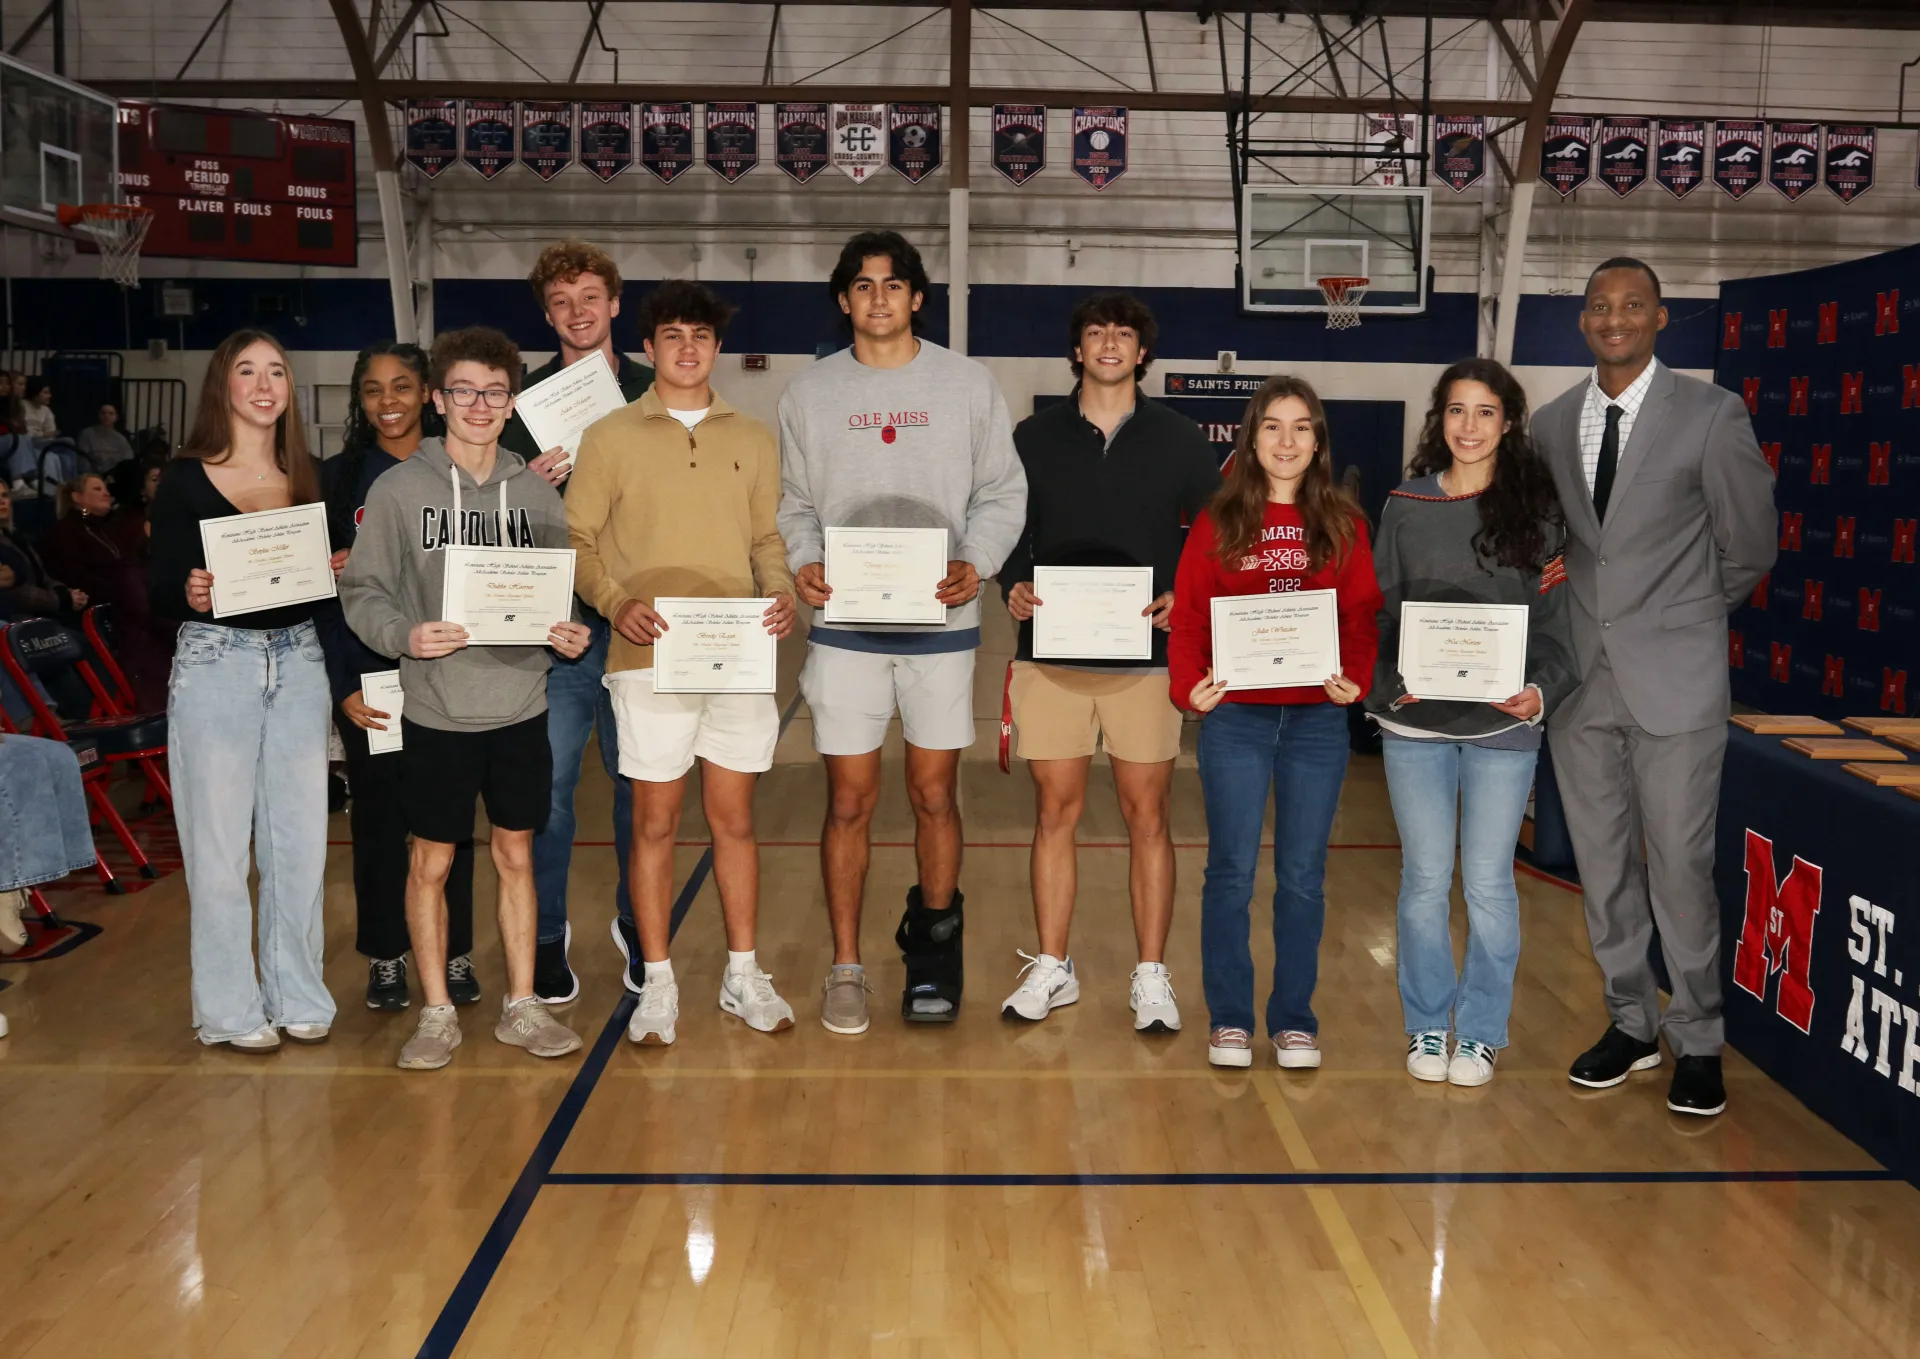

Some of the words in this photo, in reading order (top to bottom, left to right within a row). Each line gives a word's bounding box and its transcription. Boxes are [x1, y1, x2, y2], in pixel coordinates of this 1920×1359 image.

[996, 114, 1043, 132] CHAMPIONS
[1075, 116, 1126, 135] CHAMPIONS
[1437, 122, 1482, 140] CHAMPIONS
[288, 124, 351, 144] VISITOR
[1716, 130, 1762, 148] CHAMPIONS
[194, 160, 220, 170] POSS
[1089, 166, 1110, 174] 2024
[184, 170, 230, 184] PERIOD
[288, 185, 327, 199] BONUS
[178, 198, 224, 213] PLAYER
[234, 202, 272, 216] FOULS
[296, 206, 334, 220] FOULS
[1188, 380, 1231, 390] SAINTS
[1234, 380, 1264, 390] PRID
[849, 412, 882, 427] OLE
[888, 412, 928, 425] MISS
[422, 506, 536, 551] CAROLINA
[1261, 526, 1304, 542] MART
[1264, 548, 1308, 572] XC
[1269, 578, 1301, 594] 2022
[1770, 905, 1784, 938] ST
[1733, 828, 1823, 1036] M
[1848, 894, 1903, 986] ST.
